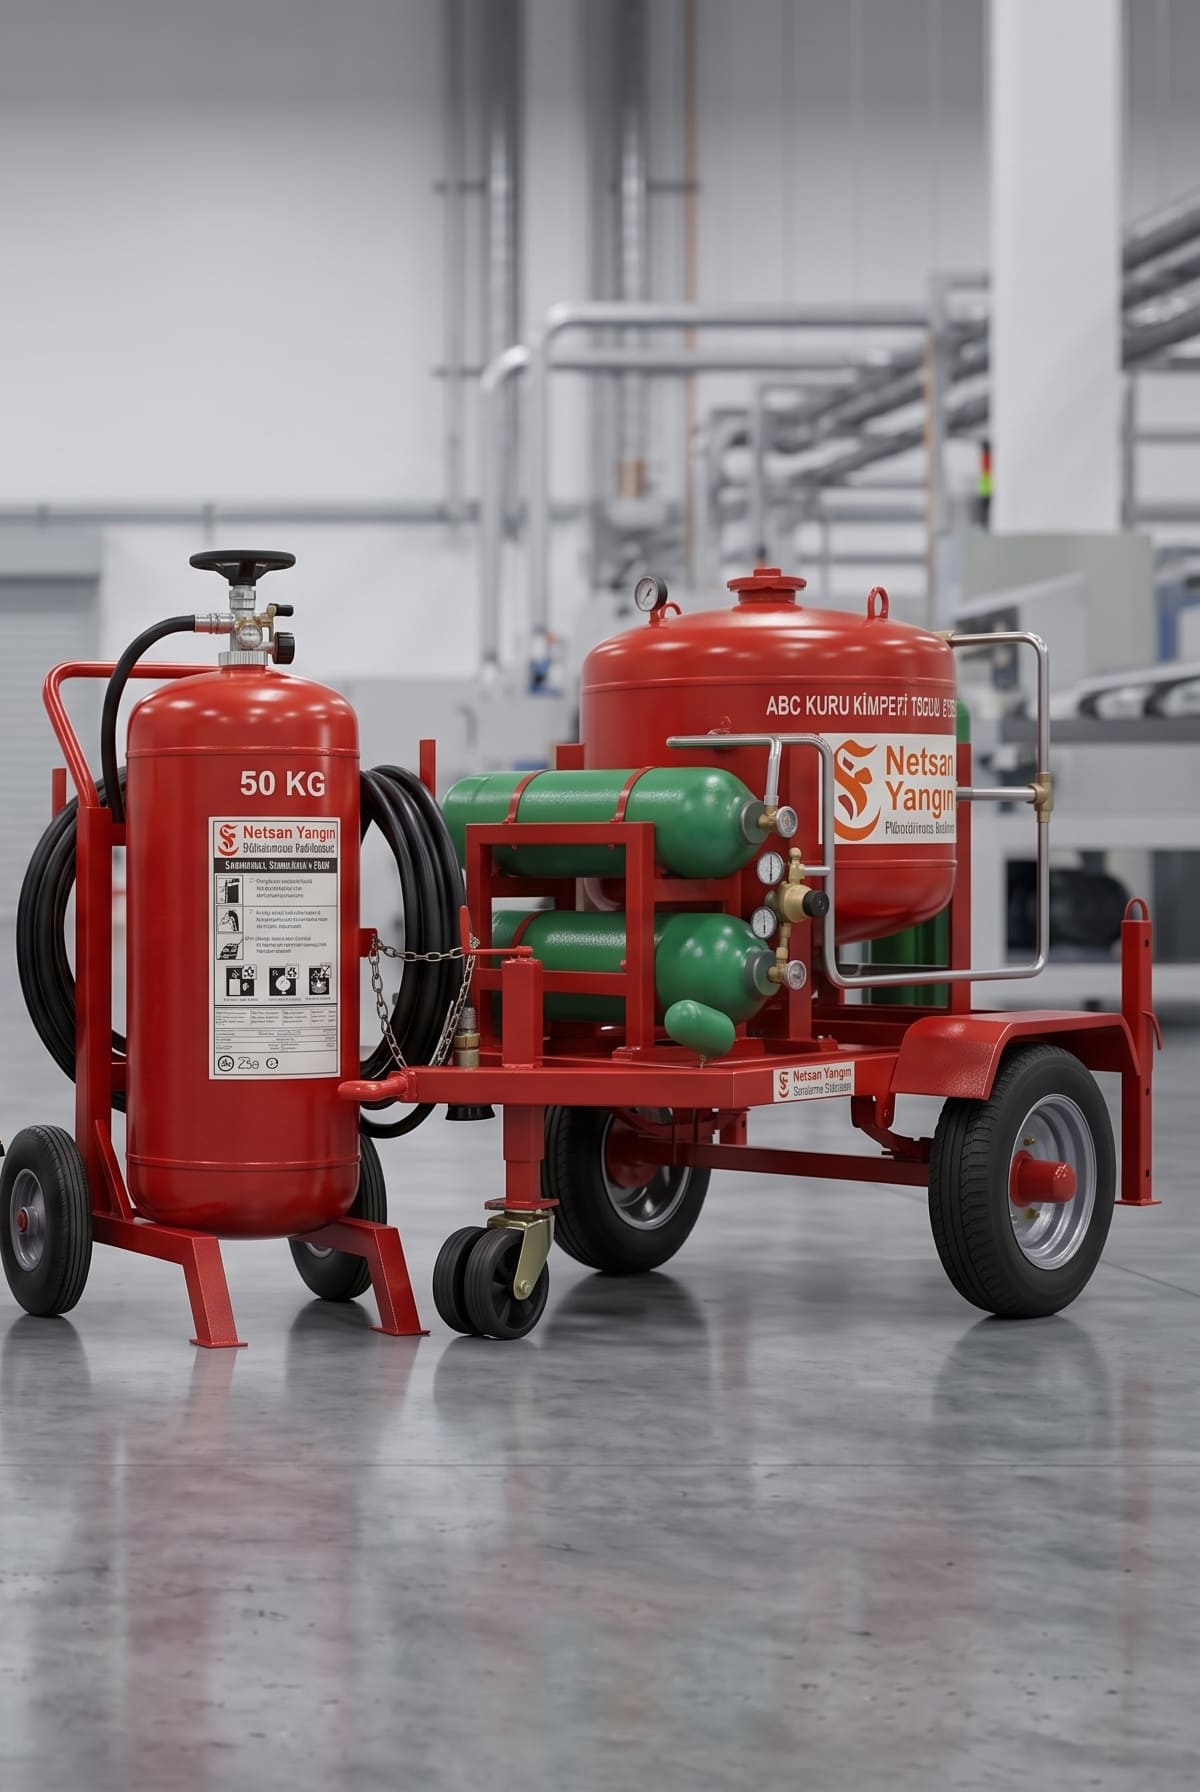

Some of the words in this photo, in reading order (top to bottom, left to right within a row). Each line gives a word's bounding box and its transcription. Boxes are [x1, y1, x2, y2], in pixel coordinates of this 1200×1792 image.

[766, 696, 801, 716] ABC
[806, 695, 850, 716] KURU
[886, 745, 953, 776] Netsan
[240, 770, 276, 796] 50
[286, 771, 326, 797] KG
[885, 781, 953, 819] Yangın
[243, 825, 293, 839] Netsan
[296, 825, 336, 843] Yangın
[793, 1070, 822, 1082] Netsan
